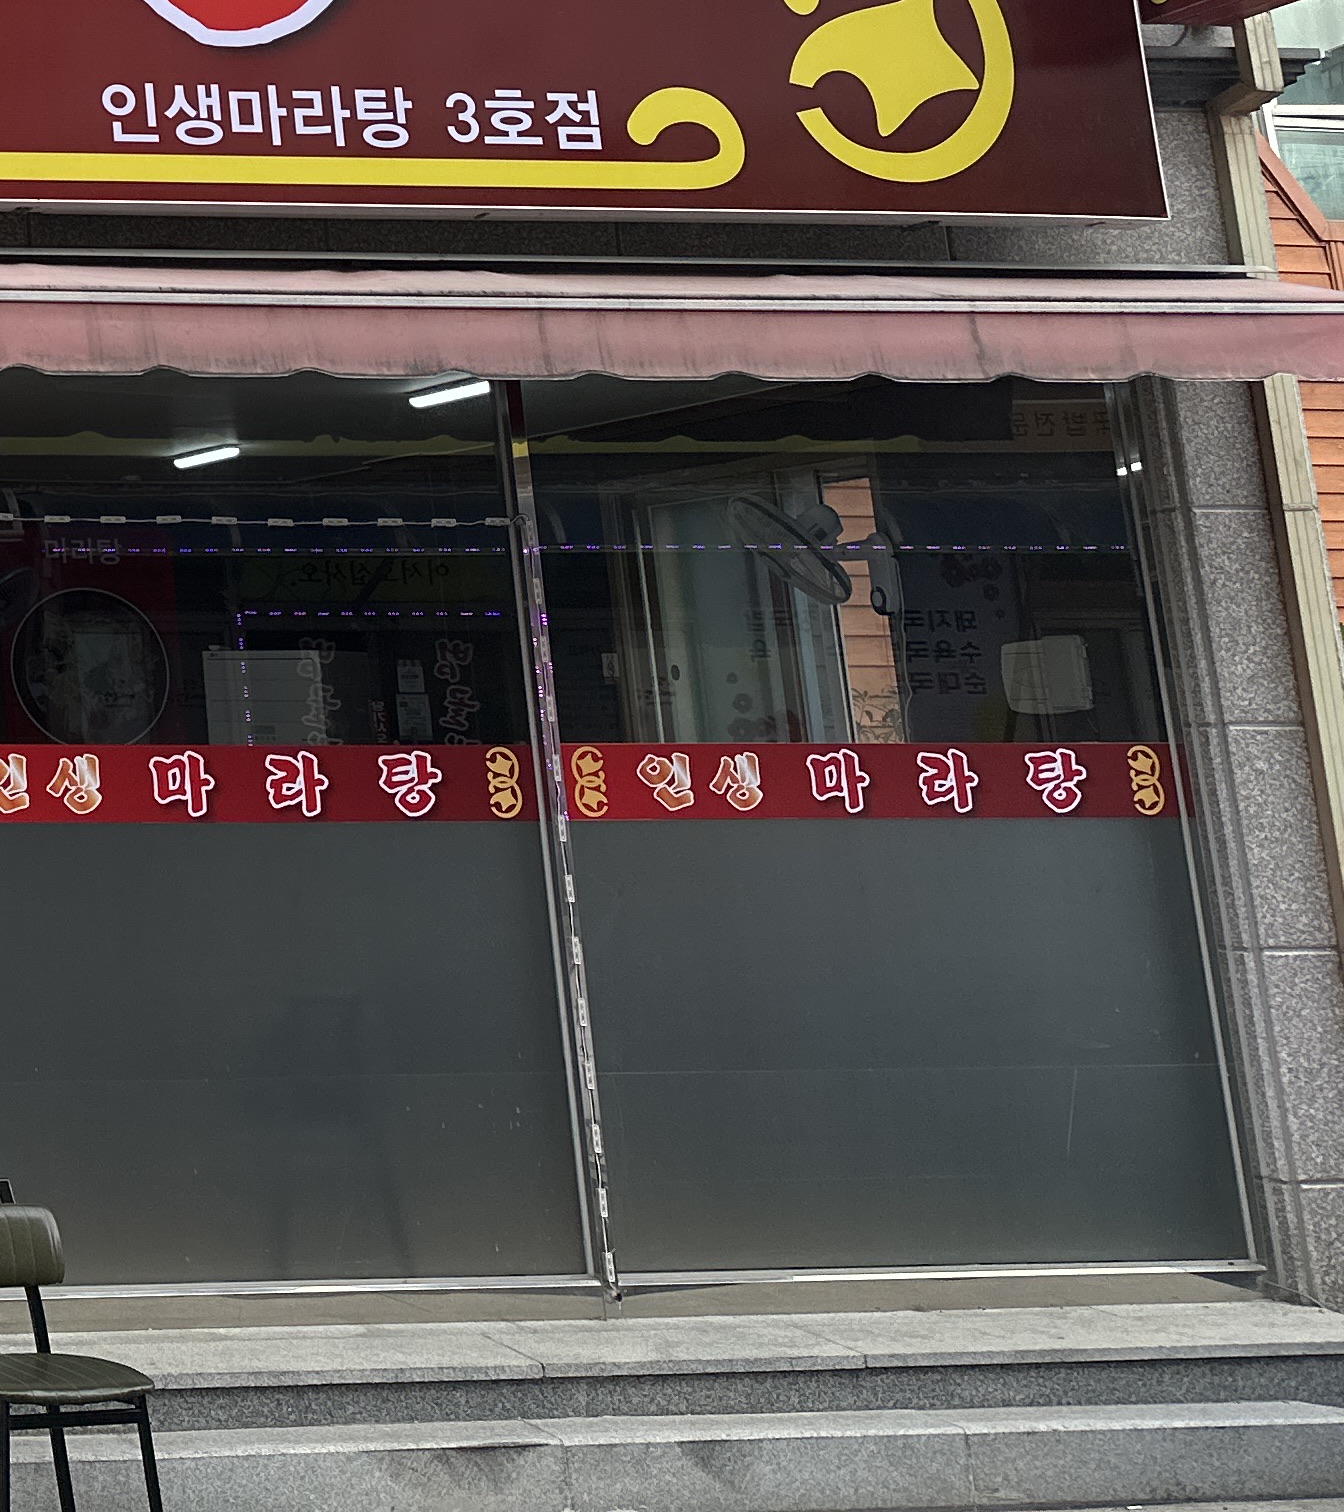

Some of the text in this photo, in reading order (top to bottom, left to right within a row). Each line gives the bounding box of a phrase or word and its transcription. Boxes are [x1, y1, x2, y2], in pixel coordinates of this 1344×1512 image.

[101, 82, 603, 150] 인생마라탕 3호점
[149, 749, 444, 818] 마라탕
[636, 747, 1088, 814] 인생 마라탕
